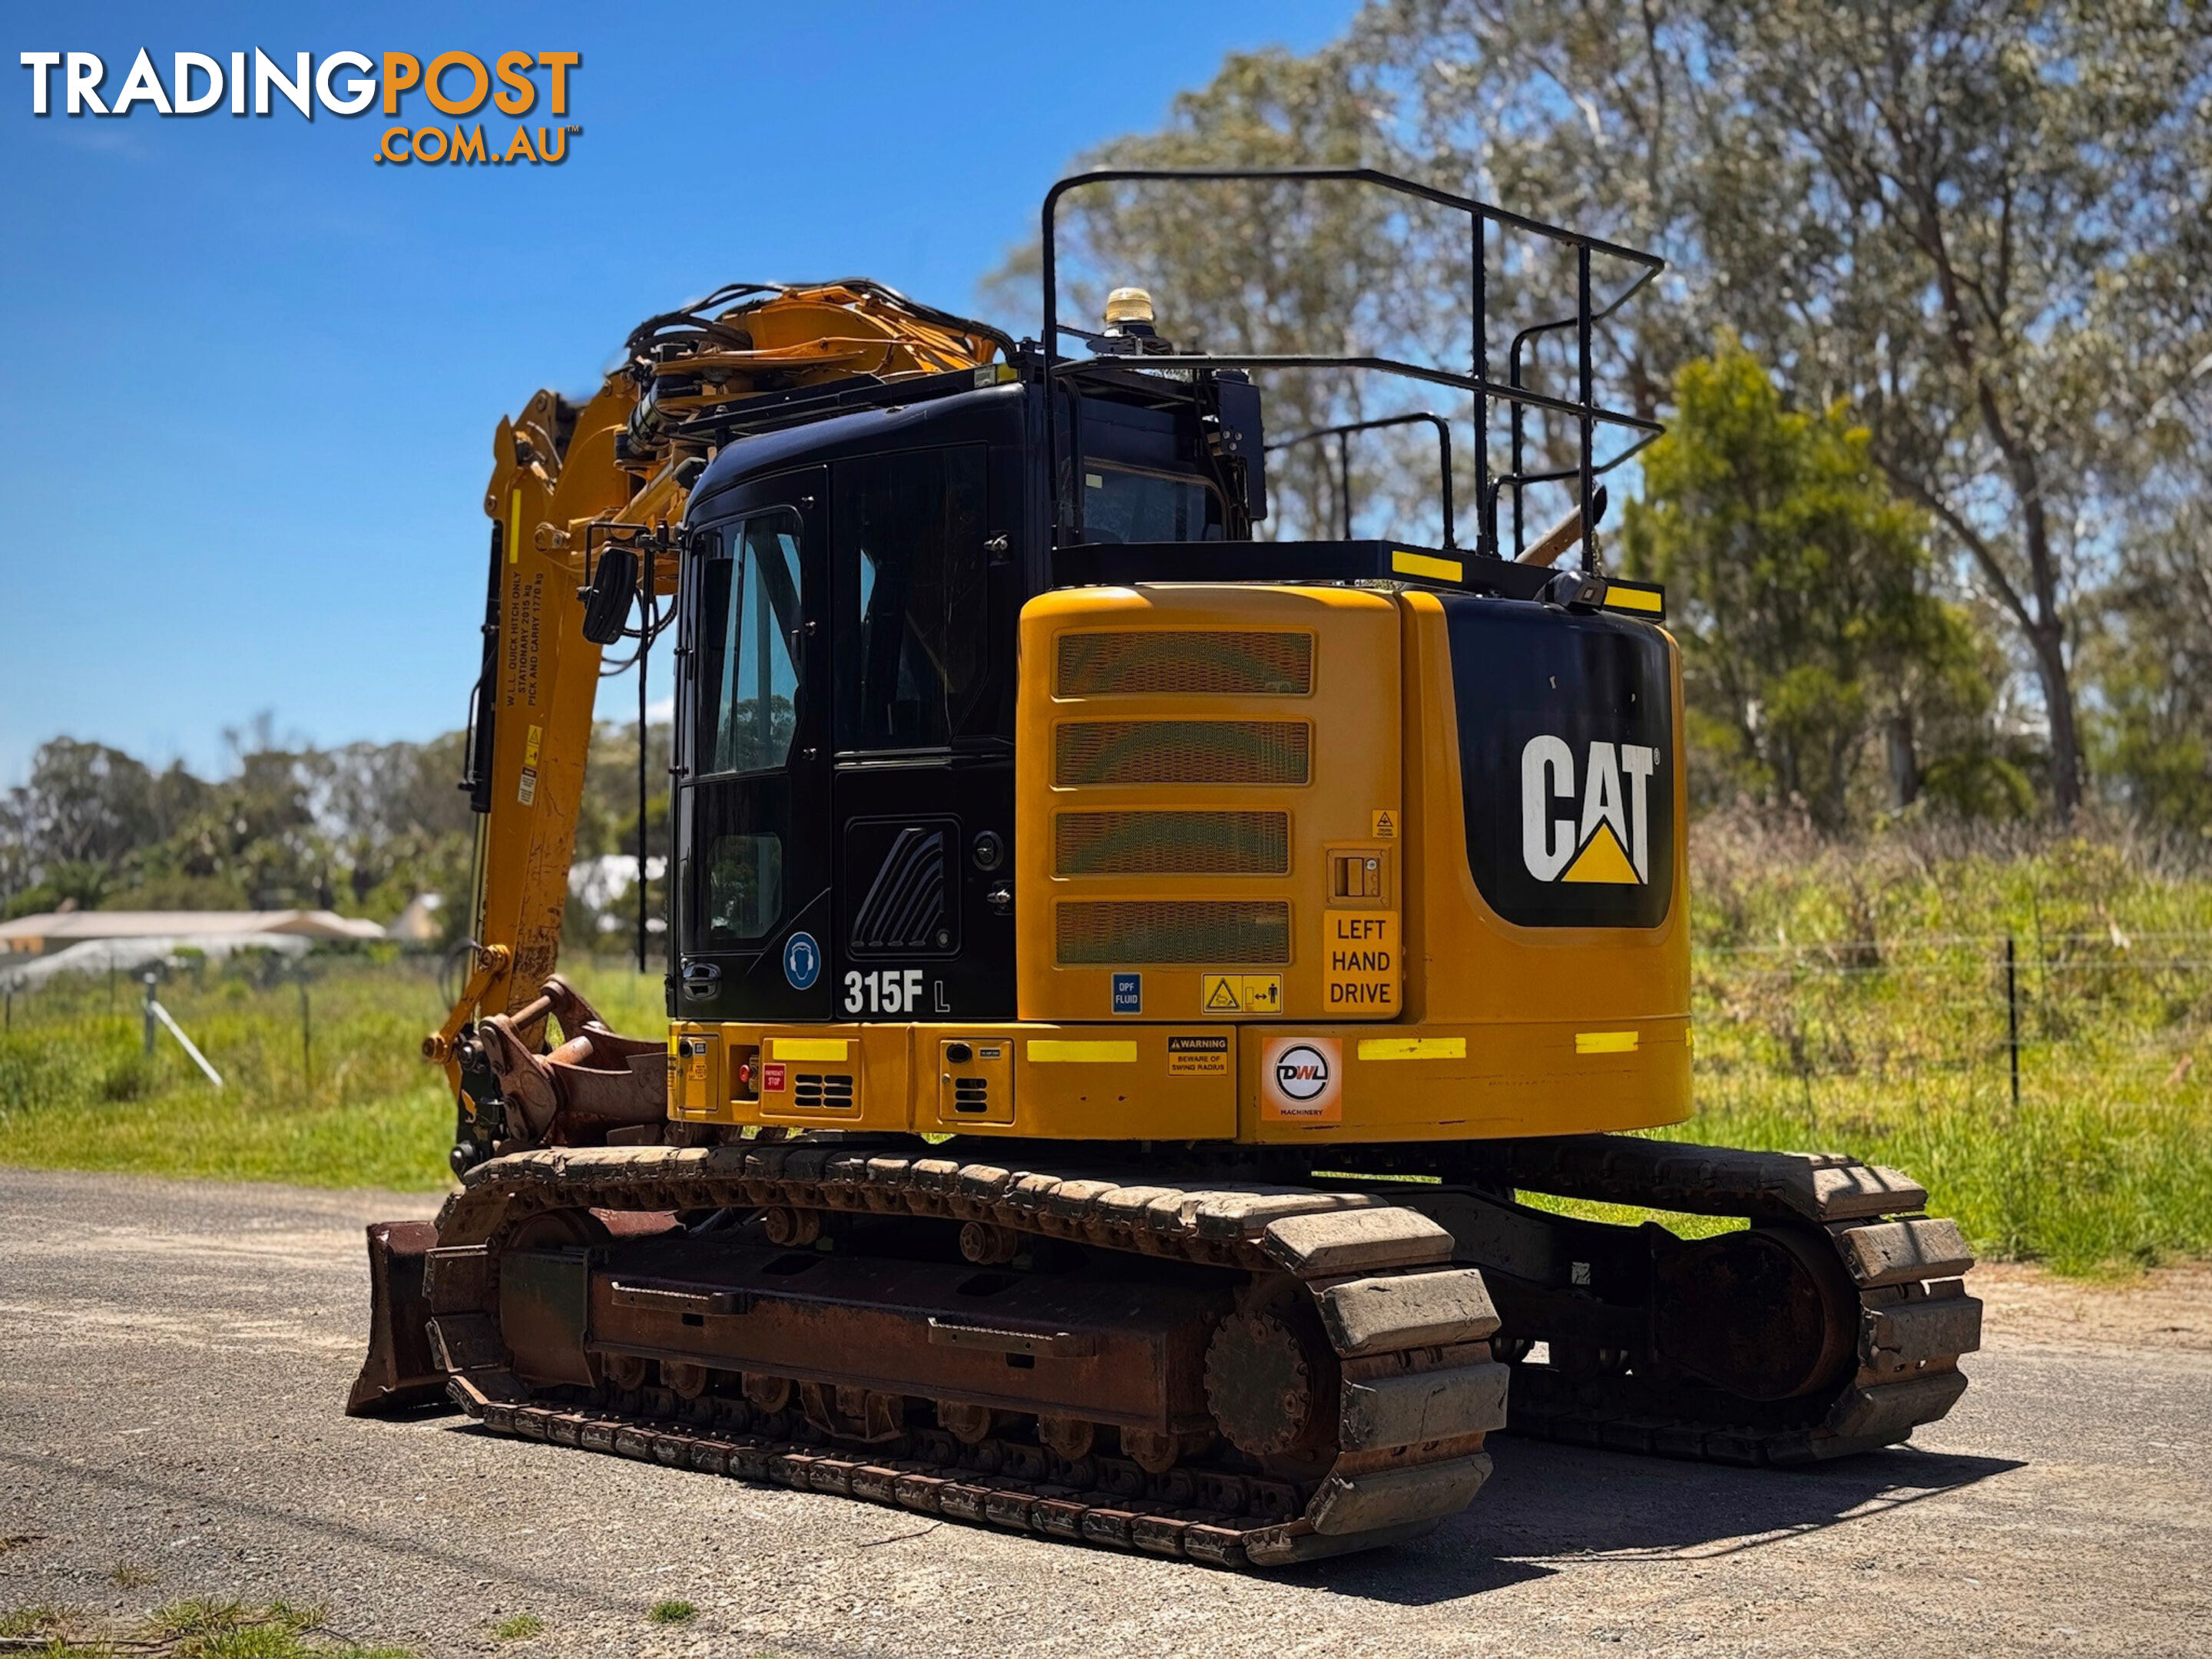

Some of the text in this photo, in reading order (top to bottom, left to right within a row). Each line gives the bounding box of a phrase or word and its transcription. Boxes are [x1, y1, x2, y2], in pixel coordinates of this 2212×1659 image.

[512, 571, 522, 599] ONLY
[511, 601, 519, 634] HITCH
[518, 584, 532, 694] STATIONARY 2015 kg
[528, 572, 544, 707] PICK AND CARRY 1770 kg
[508, 637, 518, 670] QUICK
[1522, 734, 1654, 885] CAT
[1337, 919, 1386, 939] LEFT
[1333, 951, 1390, 971] HAND
[844, 969, 951, 1013] 315F L
[1115, 994, 1138, 1004] FLUID
[1330, 983, 1392, 1003] DRIVE
[1181, 1040, 1226, 1048] WARNING
[1279, 1065, 1328, 1080] DWL
